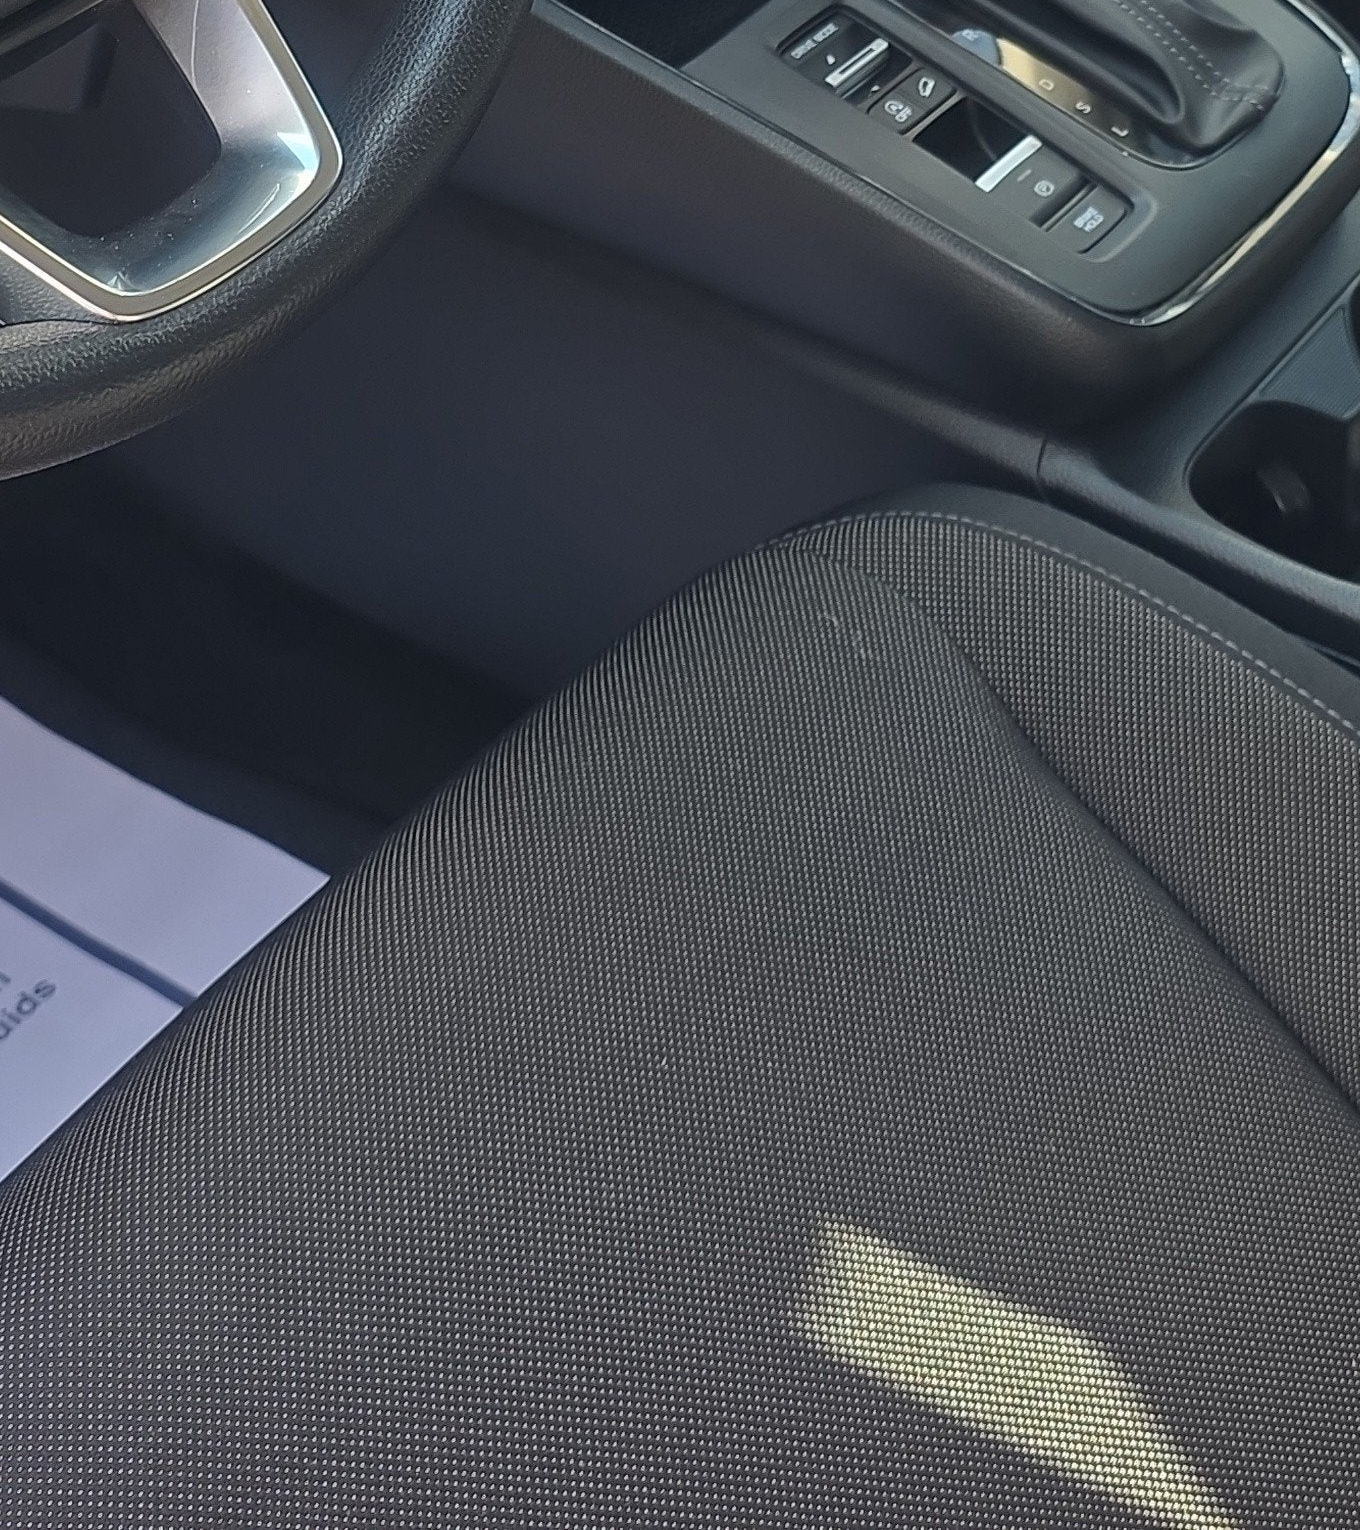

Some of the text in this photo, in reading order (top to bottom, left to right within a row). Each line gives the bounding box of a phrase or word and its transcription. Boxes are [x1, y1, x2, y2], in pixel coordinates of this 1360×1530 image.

[1039, 79, 1055, 92] D
[1076, 101, 1091, 114] S
[1111, 125, 1129, 138] L
